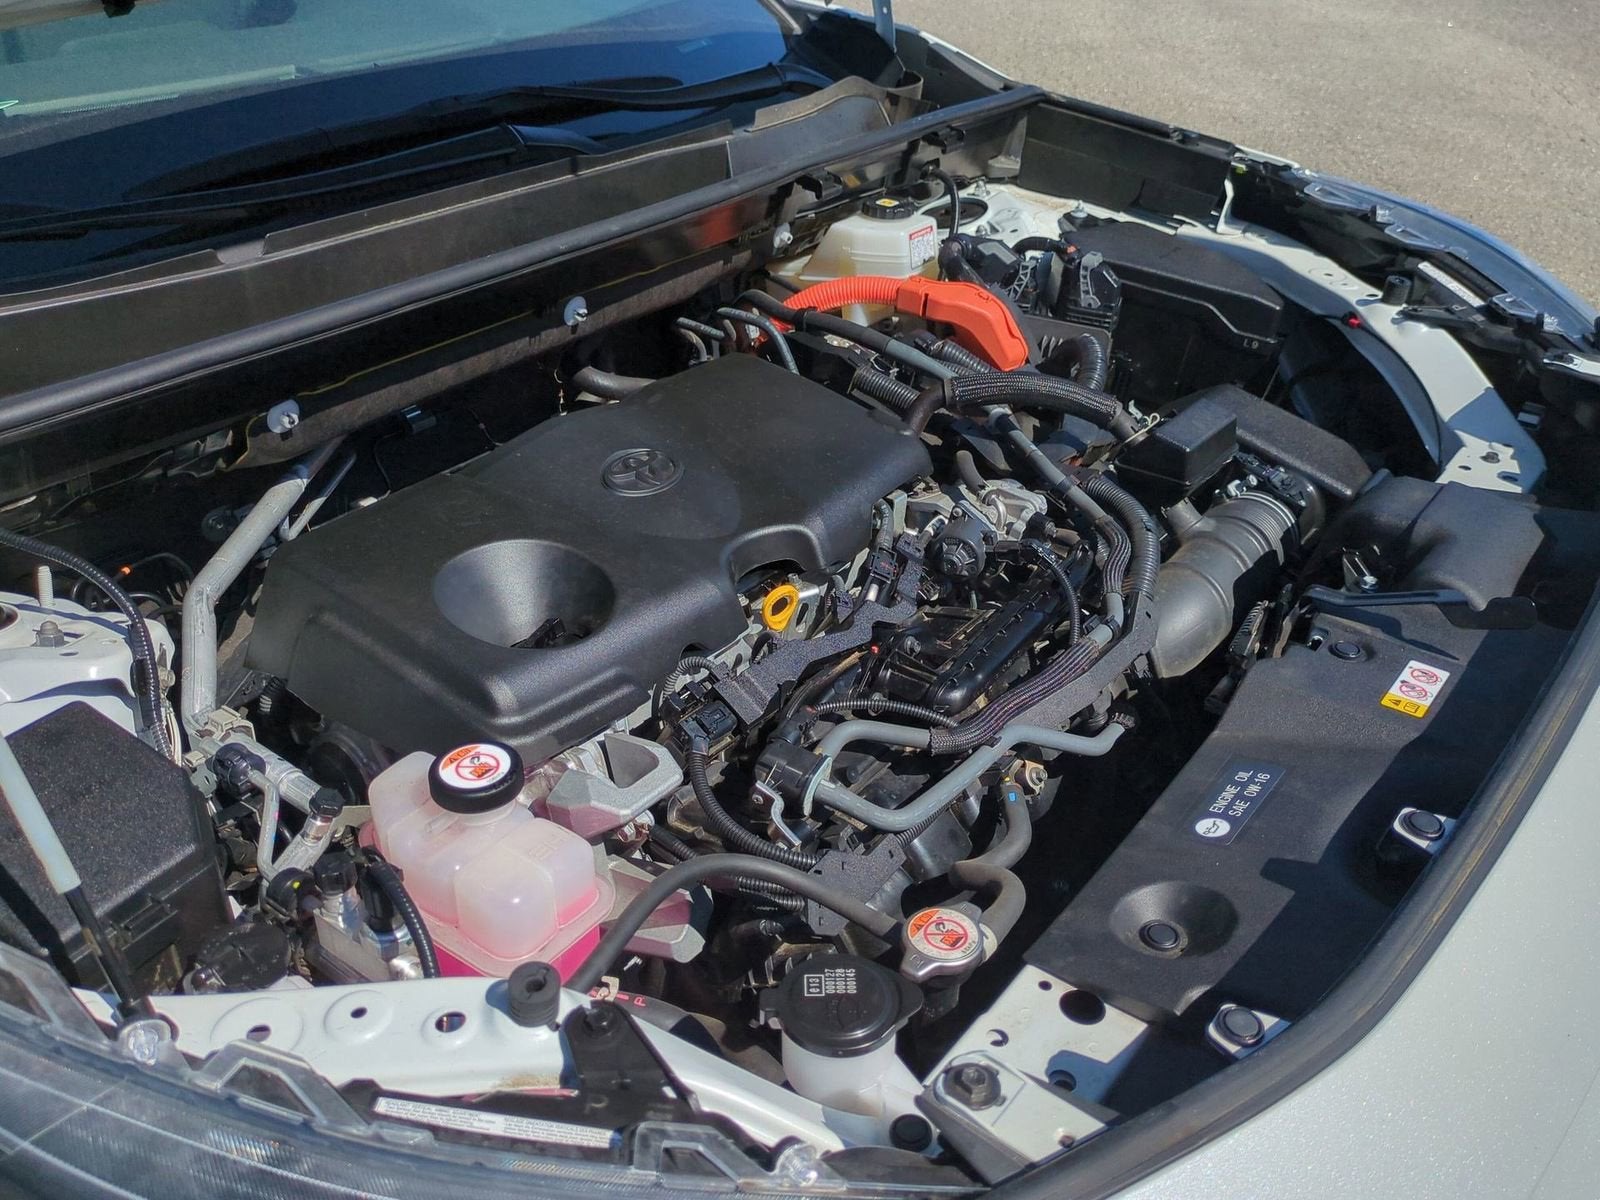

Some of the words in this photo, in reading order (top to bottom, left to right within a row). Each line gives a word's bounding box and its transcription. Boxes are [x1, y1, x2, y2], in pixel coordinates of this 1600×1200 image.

[1209, 784, 1240, 813] ENGINE
[1234, 770, 1253, 782] OIL
[1228, 799, 1250, 817] SAE
[1243, 772, 1271, 797] 0W-16
[808, 977, 820, 993] e13
[825, 968, 836, 994] 000127
[845, 968, 857, 994] 000145
